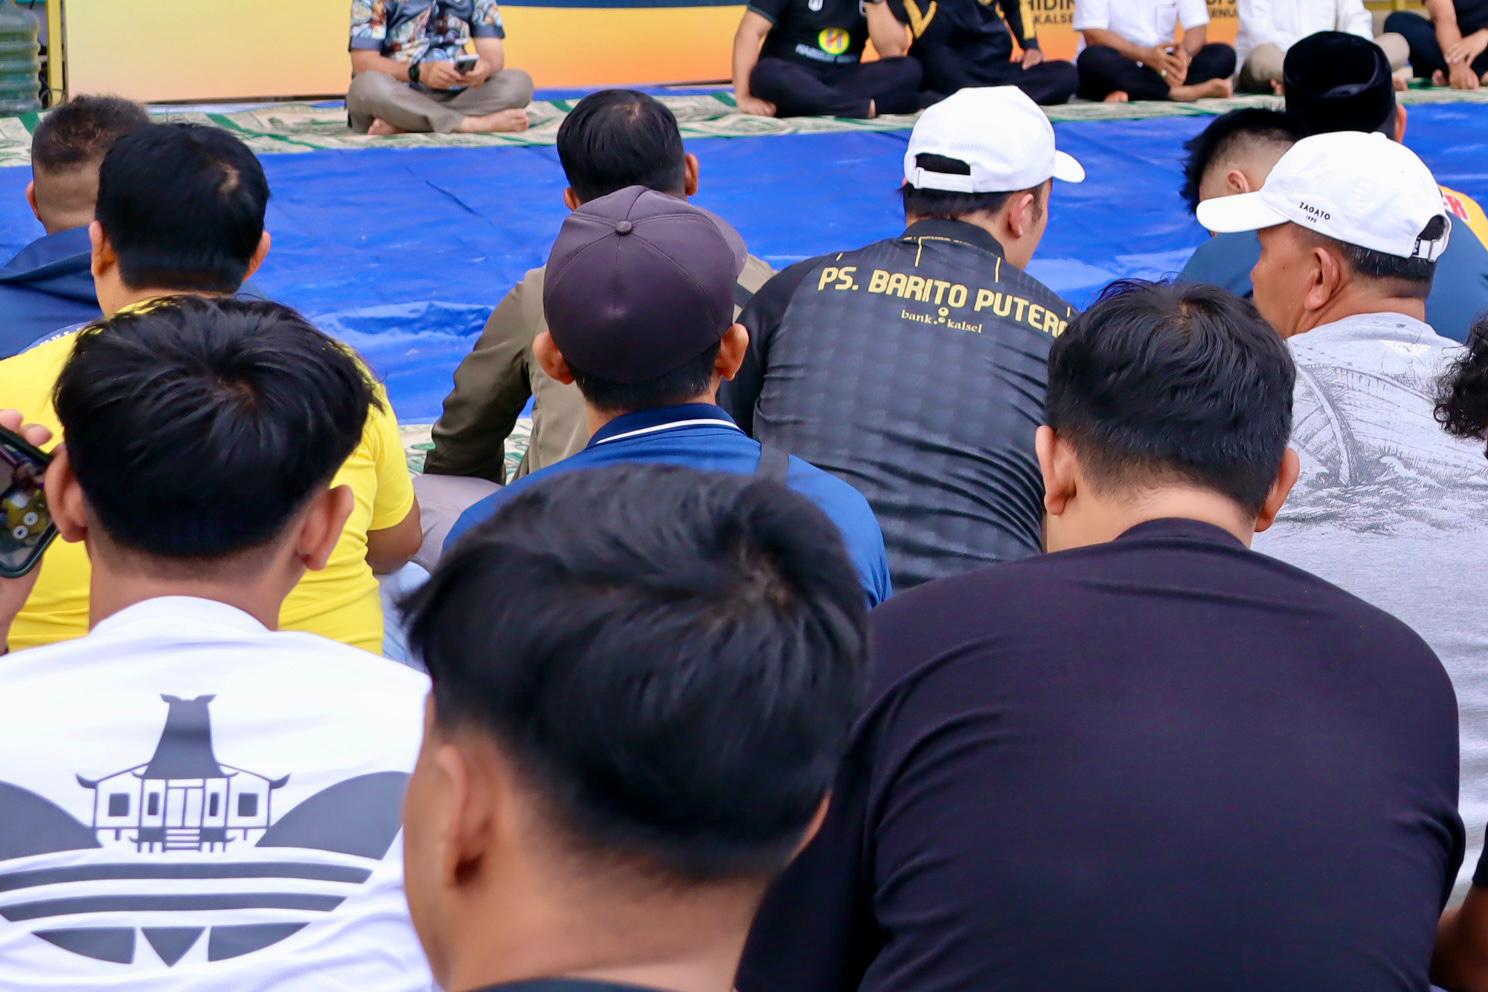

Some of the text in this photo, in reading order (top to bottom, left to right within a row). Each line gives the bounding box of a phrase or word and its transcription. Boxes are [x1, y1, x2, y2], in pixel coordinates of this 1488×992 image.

[817, 266, 858, 291] PS.
[867, 270, 967, 308] BARITO
[901, 309, 983, 333] bank kalsel
